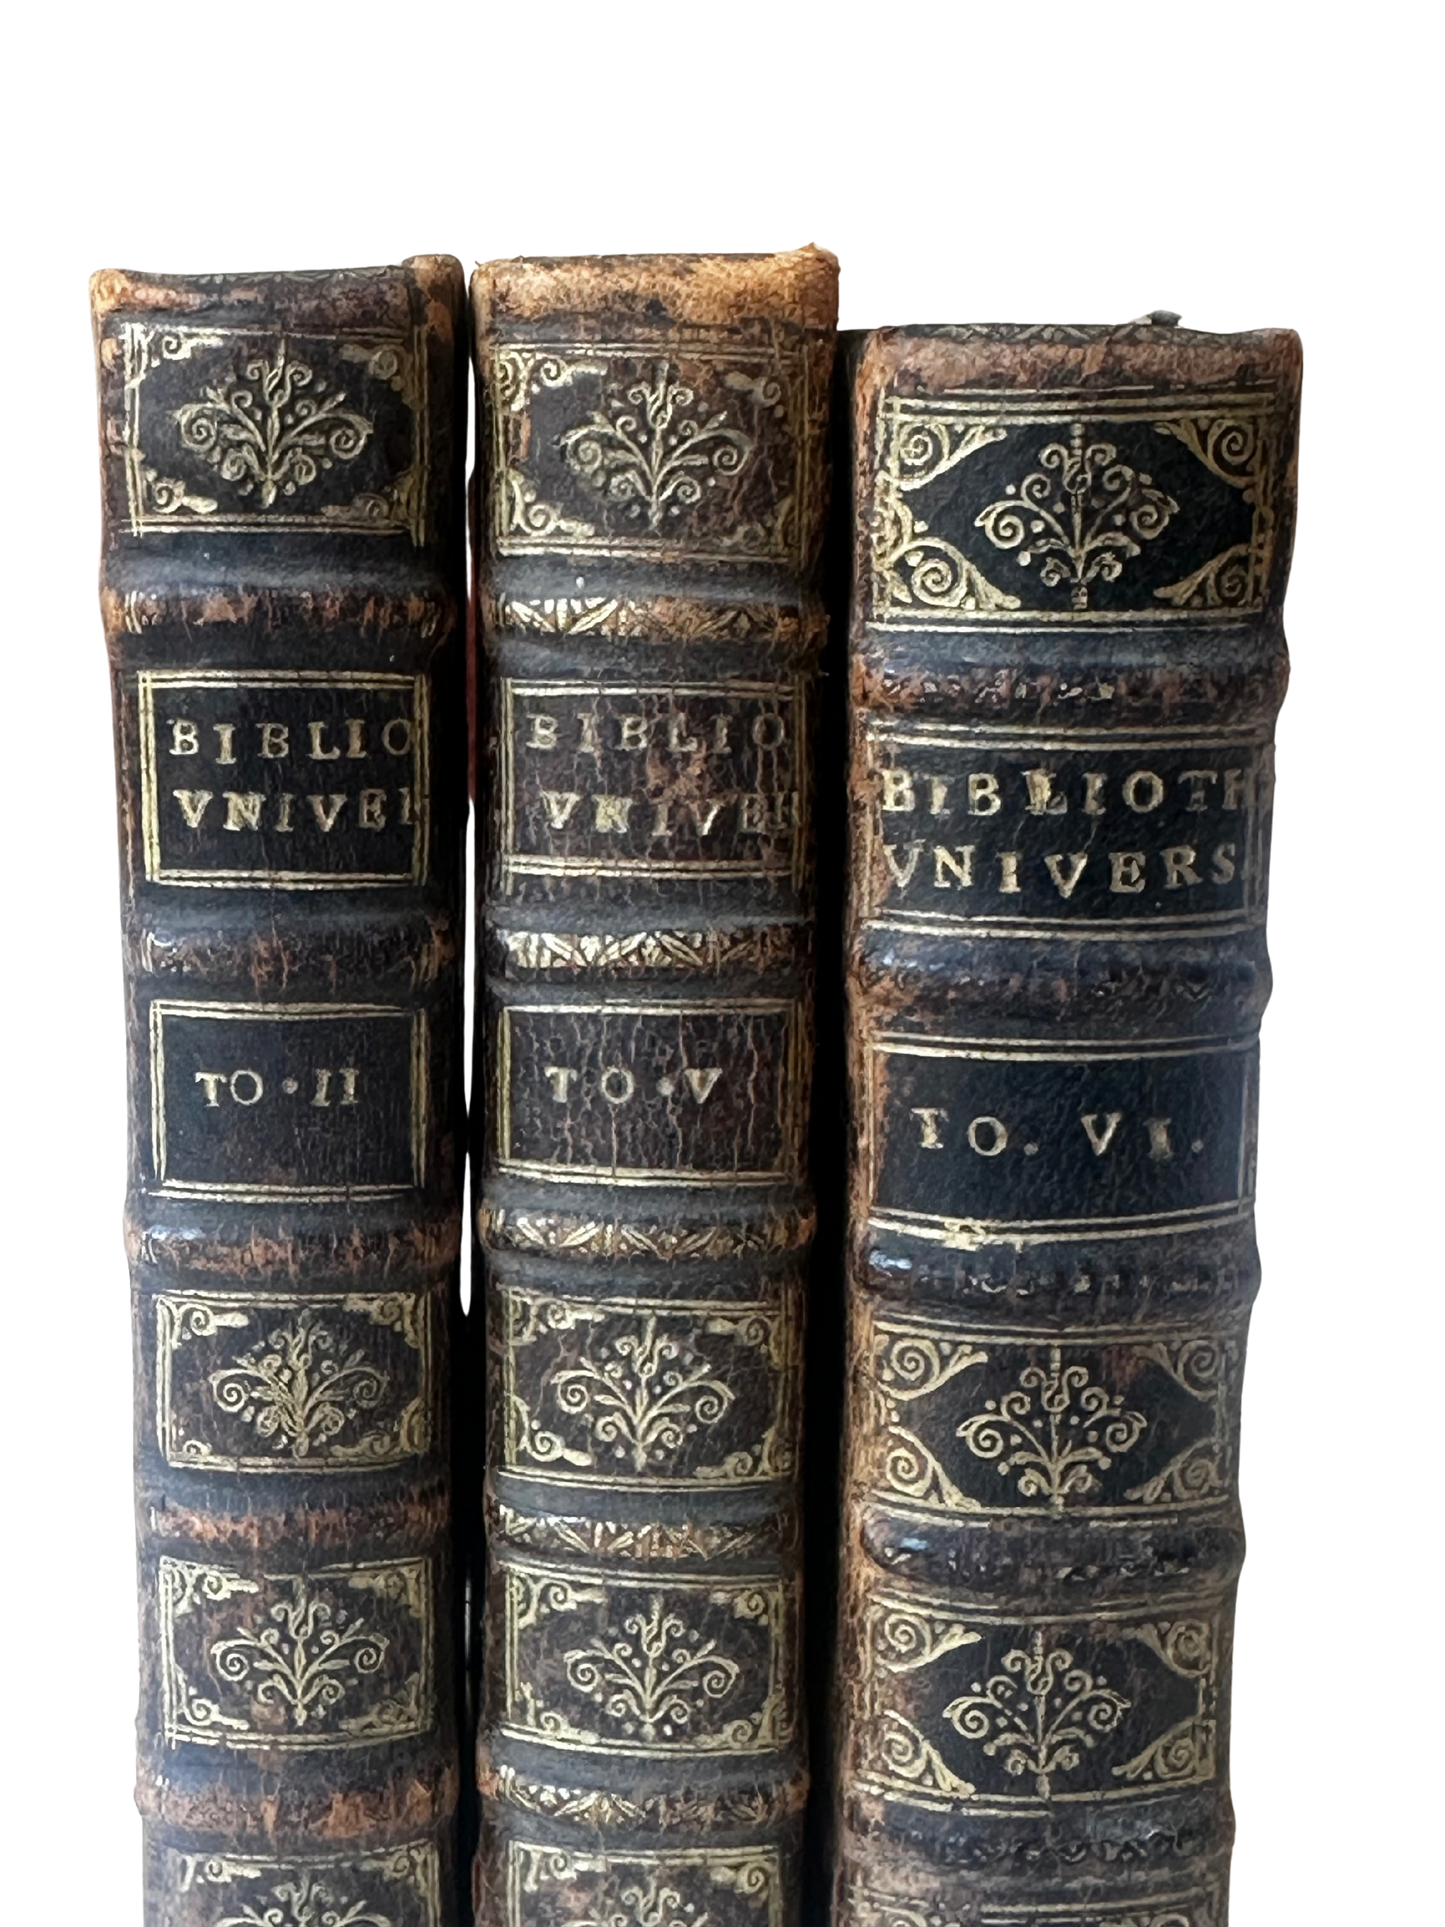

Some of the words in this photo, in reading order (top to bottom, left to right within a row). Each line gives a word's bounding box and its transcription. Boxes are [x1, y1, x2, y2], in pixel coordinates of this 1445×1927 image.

[166, 717, 412, 765] BIBLIO
[526, 711, 786, 753] BIBLIO
[883, 839, 1236, 899] VNIVERS
